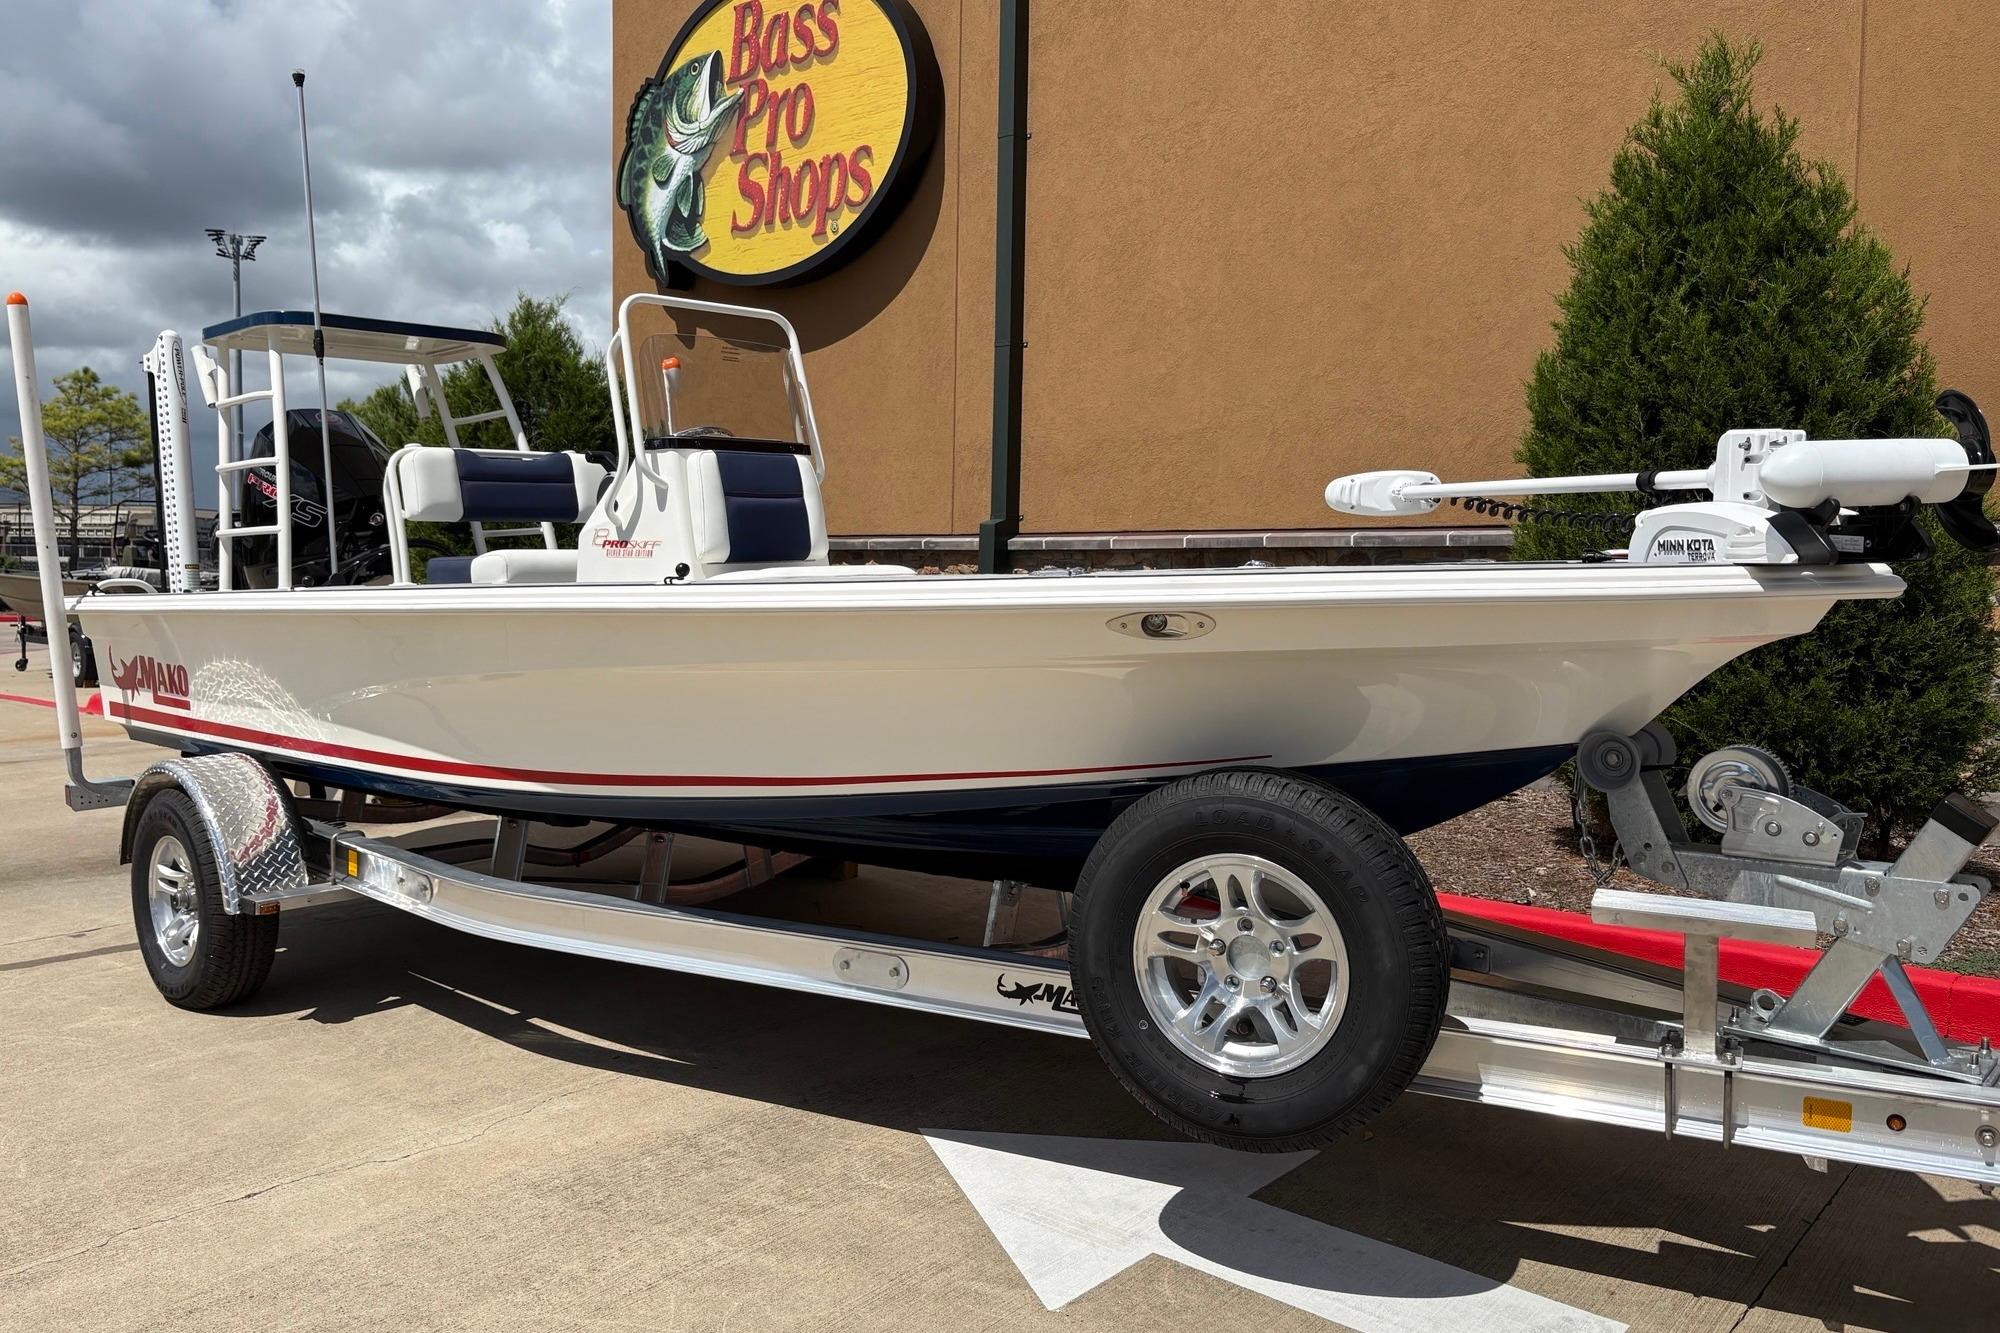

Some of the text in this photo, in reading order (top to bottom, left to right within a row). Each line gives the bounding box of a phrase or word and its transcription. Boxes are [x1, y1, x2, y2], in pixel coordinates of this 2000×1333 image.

[726, 0, 841, 84] Bass
[730, 79, 815, 156] Pro
[731, 145, 874, 237] Shops
[1657, 539, 1715, 552] MINN KOTA
[1687, 552, 1716, 562] TERROVA
[138, 655, 190, 707] MAKO
[1033, 983, 1080, 1012] MA
